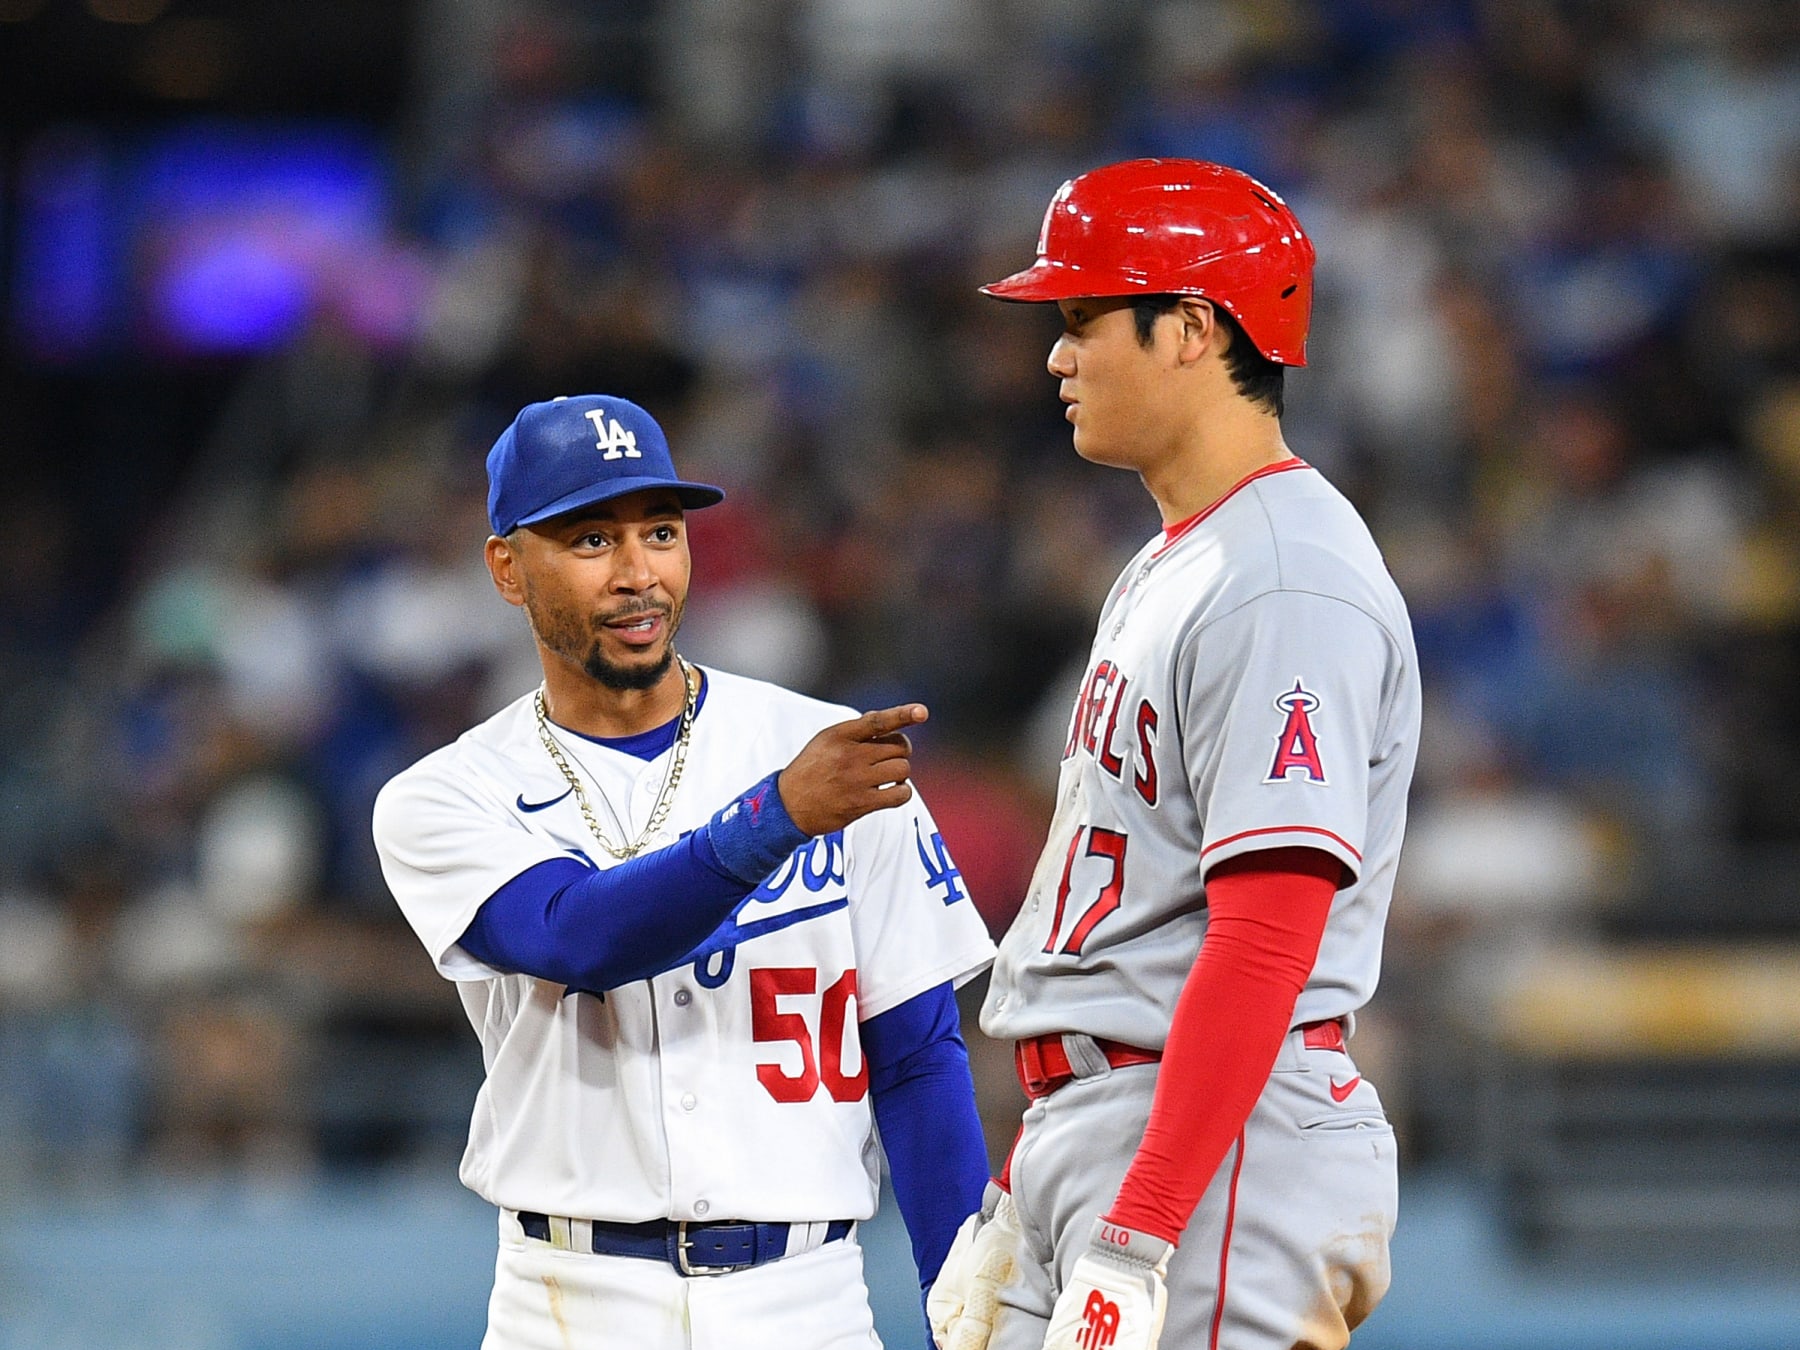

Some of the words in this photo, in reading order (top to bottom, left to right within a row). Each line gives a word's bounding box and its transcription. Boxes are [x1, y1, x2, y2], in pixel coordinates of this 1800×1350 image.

[585, 408, 642, 461] LA
[1265, 677, 1328, 784] A
[1041, 823, 1129, 957] 17
[748, 967, 869, 1104] 50
